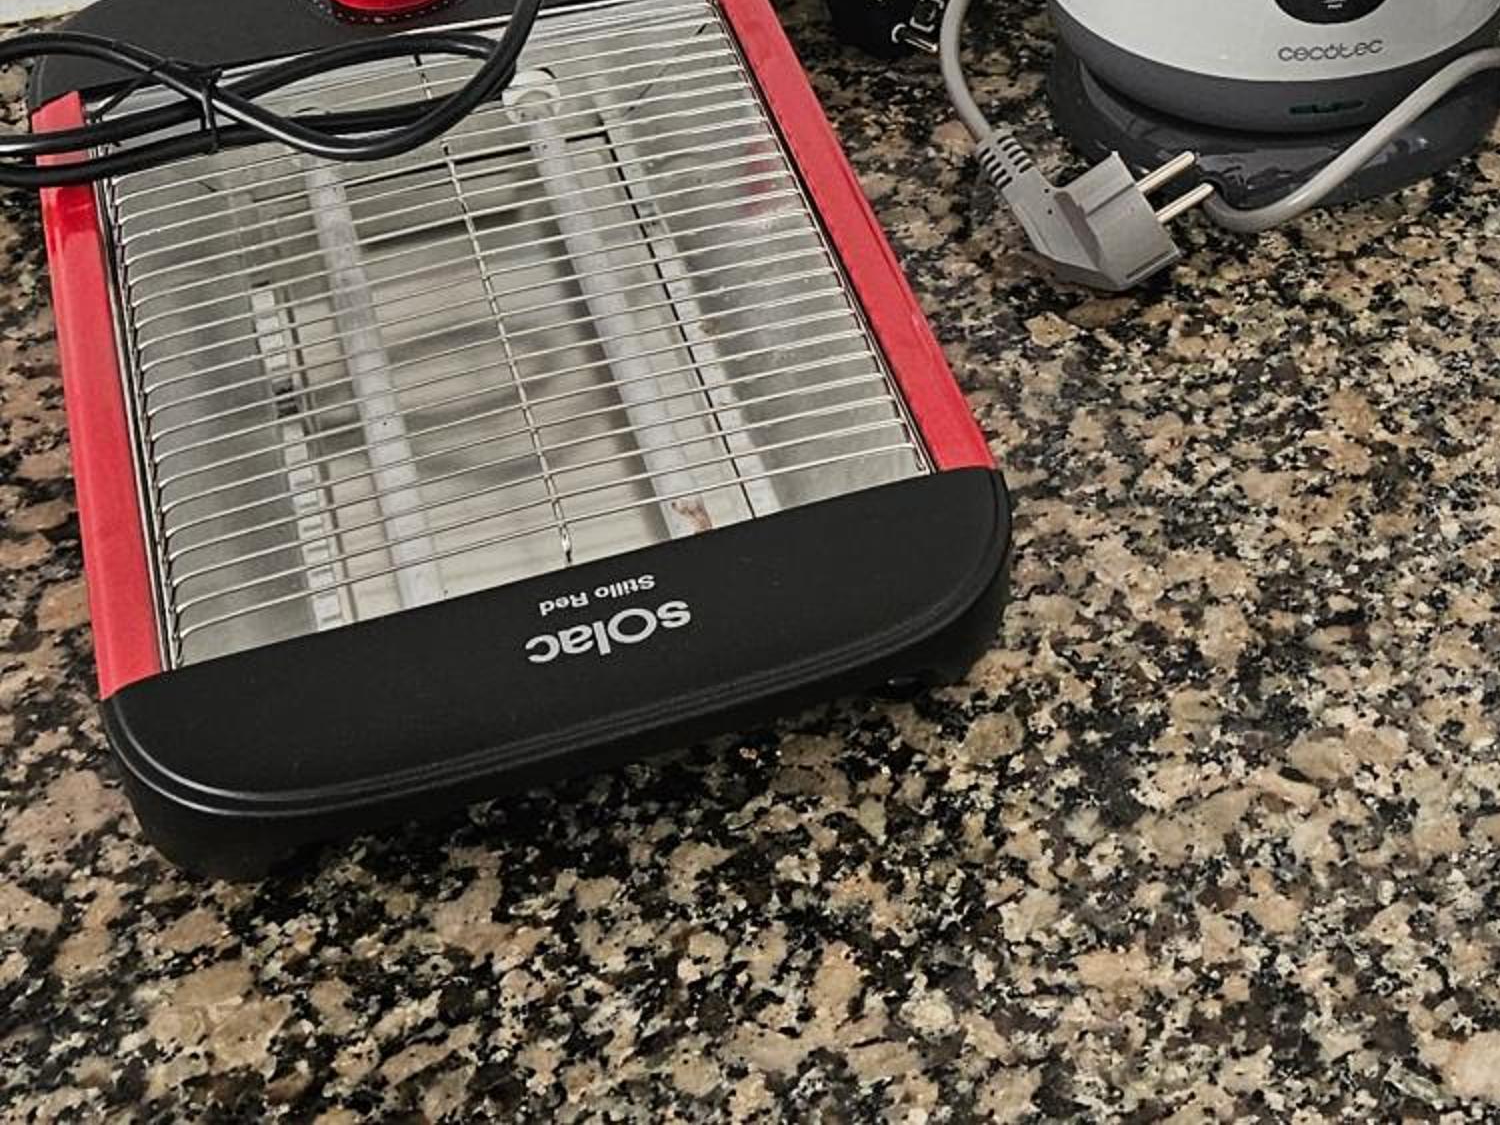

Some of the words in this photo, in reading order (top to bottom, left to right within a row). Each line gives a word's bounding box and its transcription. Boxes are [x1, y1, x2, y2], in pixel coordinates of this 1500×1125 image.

[1278, 39, 1383, 61] cecotec
[594, 574, 656, 598] Stillo
[539, 592, 589, 616] Red
